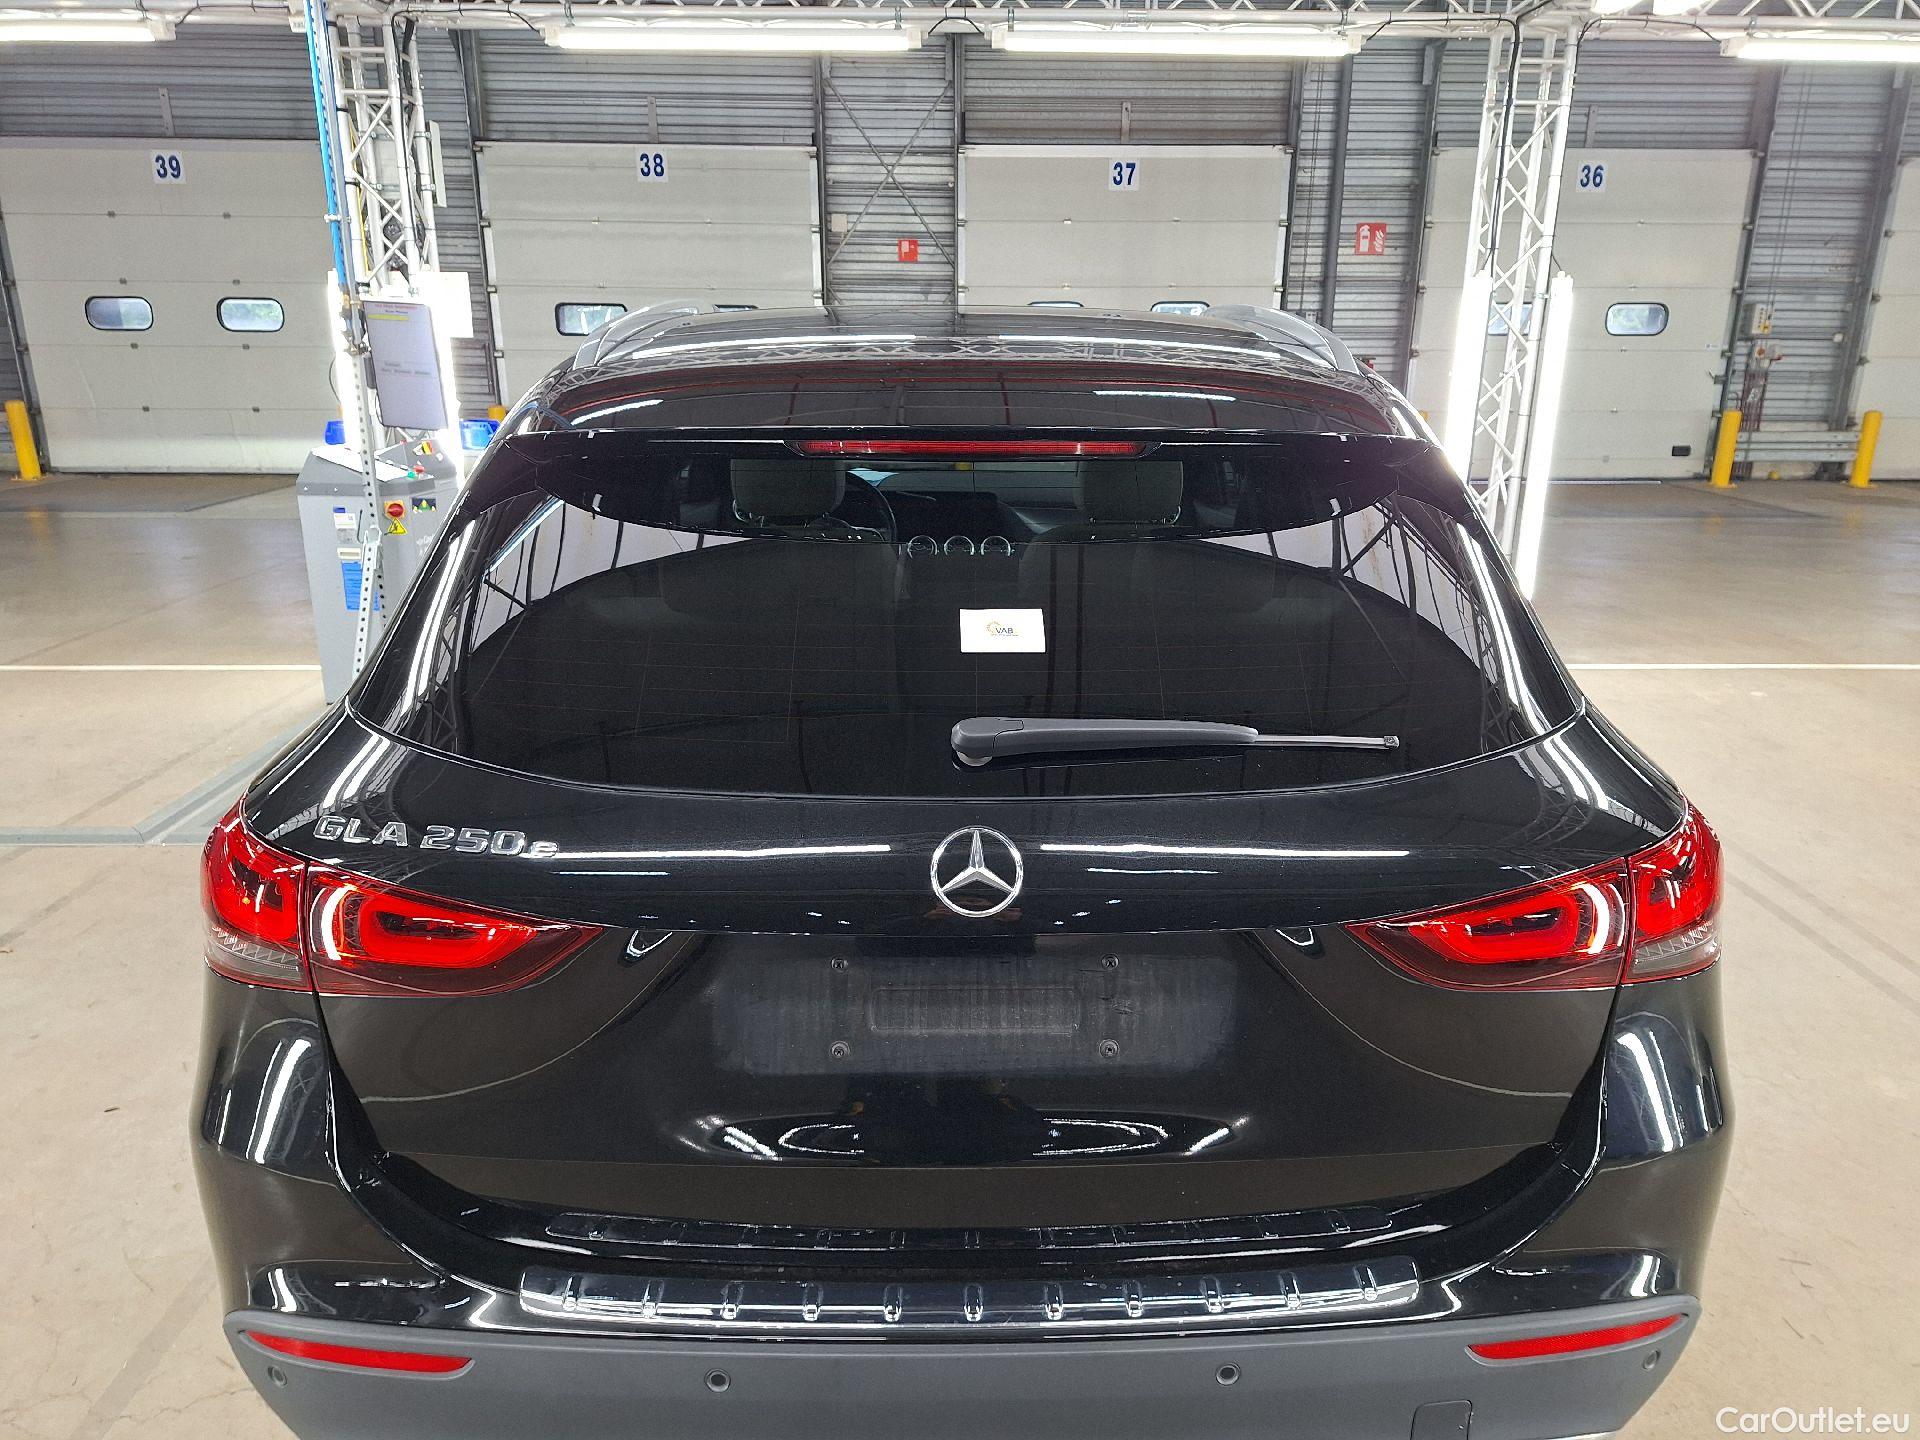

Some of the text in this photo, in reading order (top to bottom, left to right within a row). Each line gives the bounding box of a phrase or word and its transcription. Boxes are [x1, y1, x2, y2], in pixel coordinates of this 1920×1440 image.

[155, 155, 181, 179] 39
[640, 153, 665, 177] 38
[1112, 161, 1136, 186] 37
[1580, 164, 1604, 188] 36
[313, 815, 409, 847] GLA
